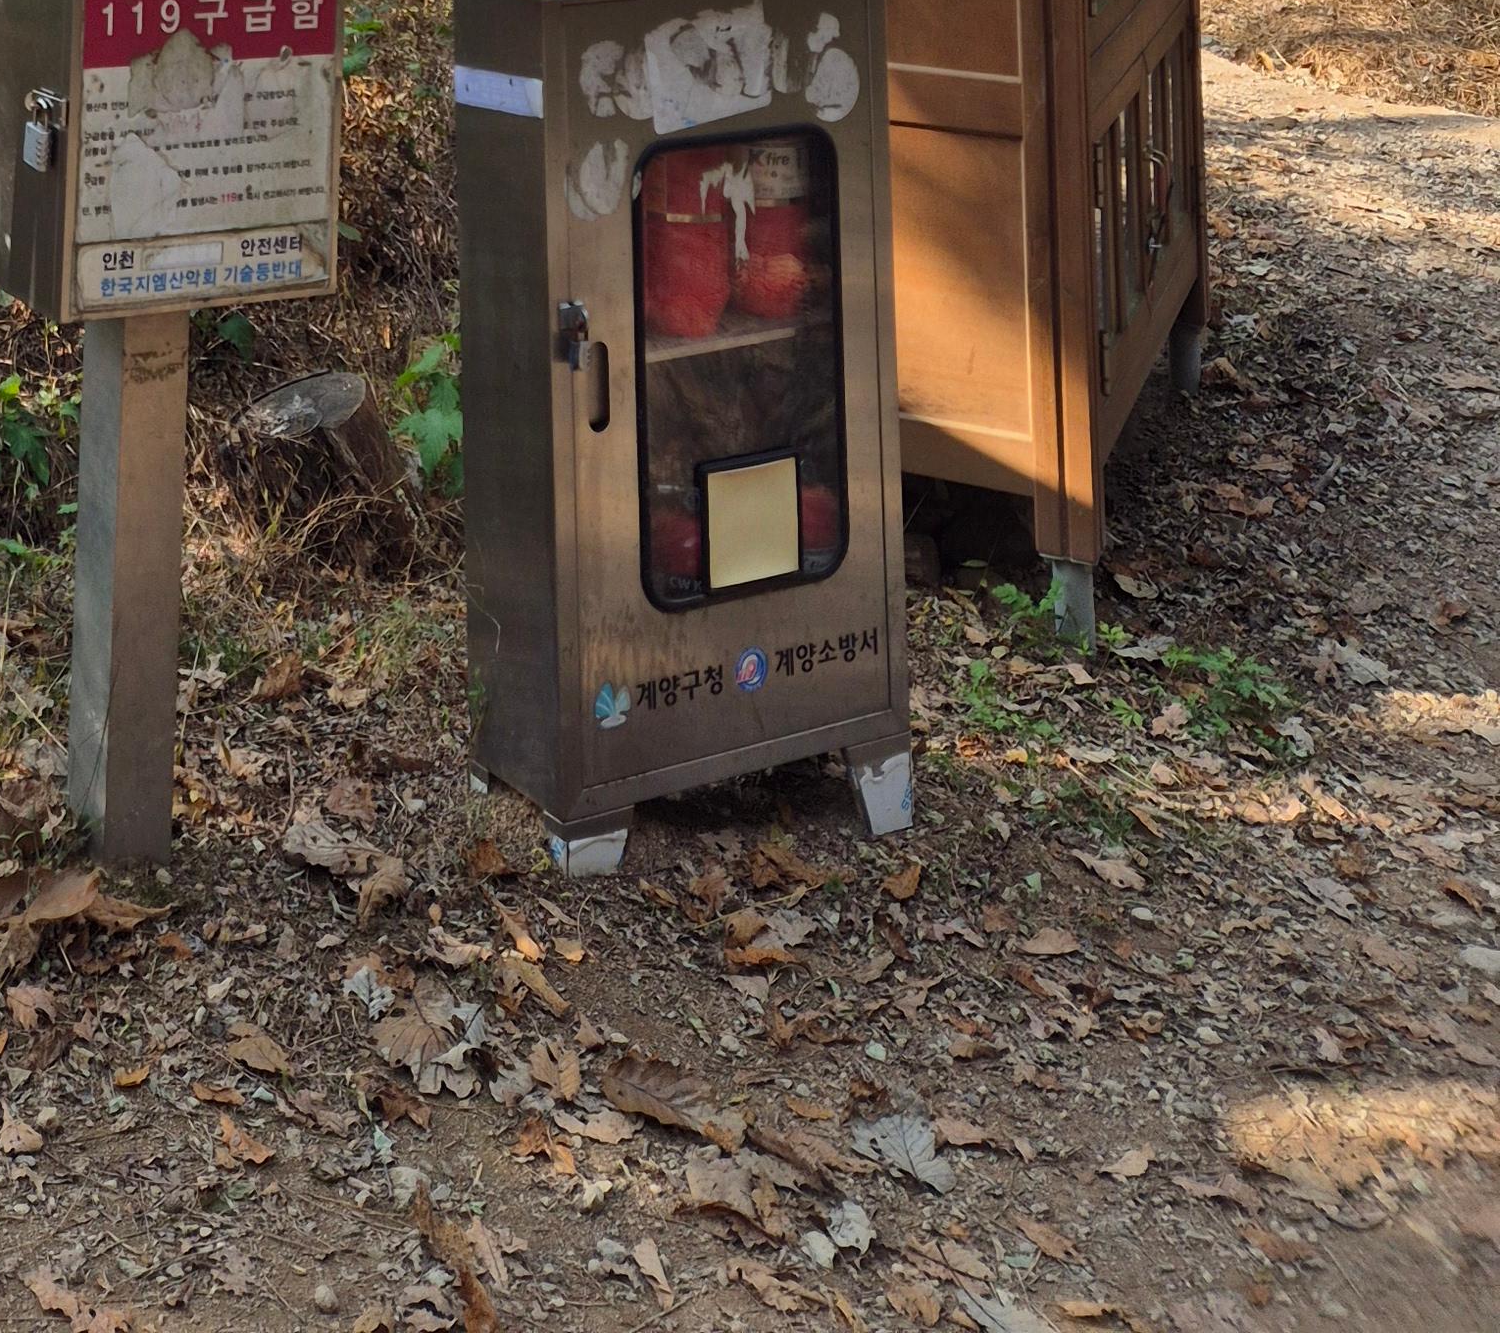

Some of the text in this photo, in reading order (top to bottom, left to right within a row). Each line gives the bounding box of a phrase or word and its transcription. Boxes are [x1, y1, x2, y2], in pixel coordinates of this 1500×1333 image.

[102, 235, 302, 273] 인천 안전센터
[101, 260, 302, 298] 한국지엠산악회 기술등반대
[637, 627, 879, 711] 계양구청 계양소방서
